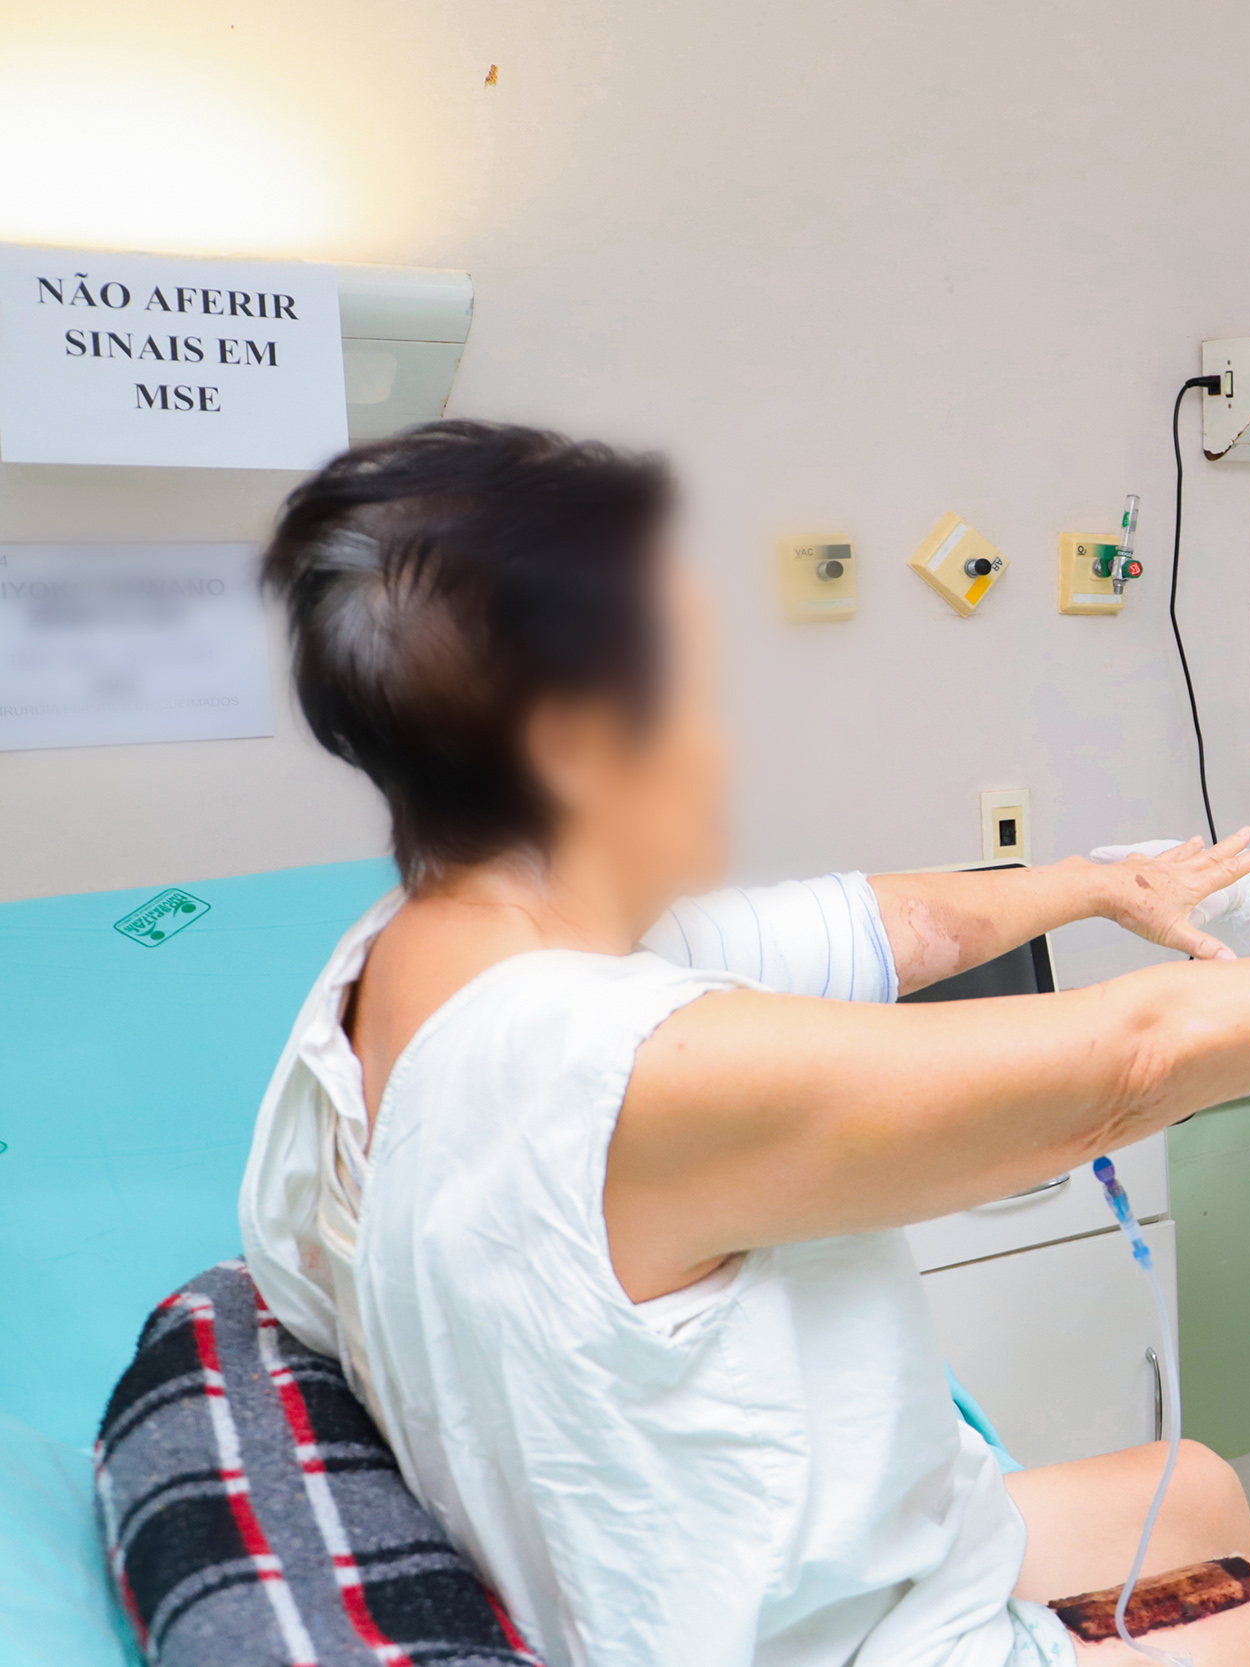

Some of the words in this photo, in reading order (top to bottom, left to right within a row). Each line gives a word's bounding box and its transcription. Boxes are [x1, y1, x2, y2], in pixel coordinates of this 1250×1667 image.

[36, 272, 131, 309] NÃO
[145, 285, 300, 321] AFERIR
[65, 328, 205, 363] SINAIS
[217, 337, 279, 367] EM
[134, 382, 222, 413] MSE
[795, 547, 814, 556] VAC
